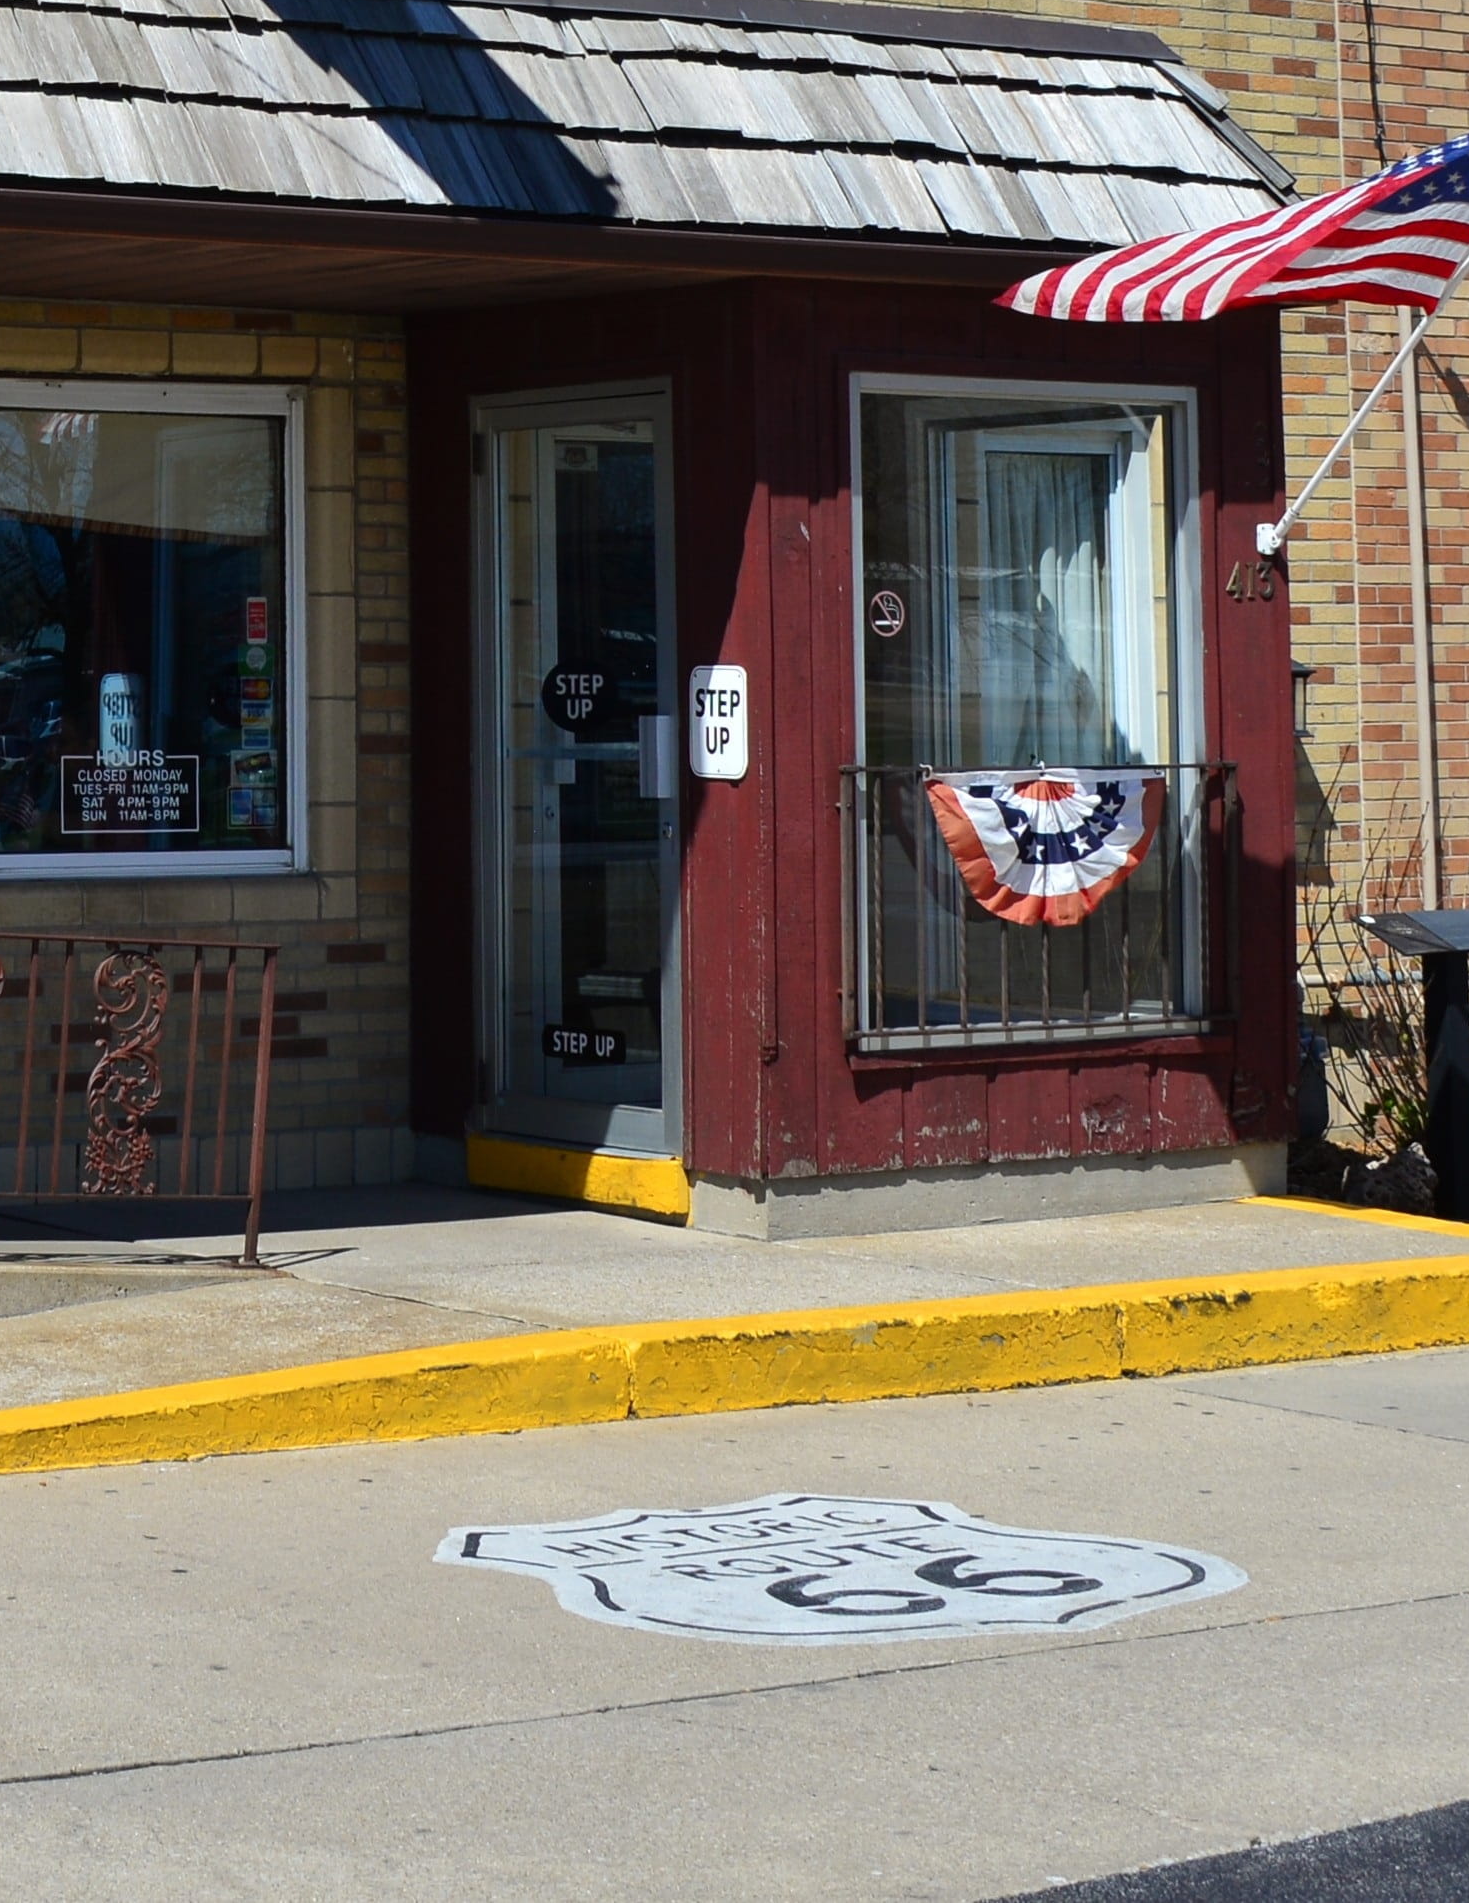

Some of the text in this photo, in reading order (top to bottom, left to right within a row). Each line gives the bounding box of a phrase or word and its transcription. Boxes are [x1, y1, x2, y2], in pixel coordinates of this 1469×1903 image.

[1225, 561, 1275, 601] 413
[555, 674, 604, 696] STEP
[567, 699, 593, 720] UP
[695, 688, 741, 718] STEP
[706, 726, 730, 755] UP
[96, 749, 165, 767] HOURS
[78, 769, 183, 782] CLOSED MONDAY
[72, 783, 126, 795] TUES-FRI
[82, 796, 105, 809] SAT
[82, 810, 107, 822] SUN
[553, 1030, 615, 1058] STEP UP
[543, 1510, 887, 1559] HISTORIC
[661, 1533, 962, 1582] ROUTE
[765, 1555, 1104, 1617] 66
